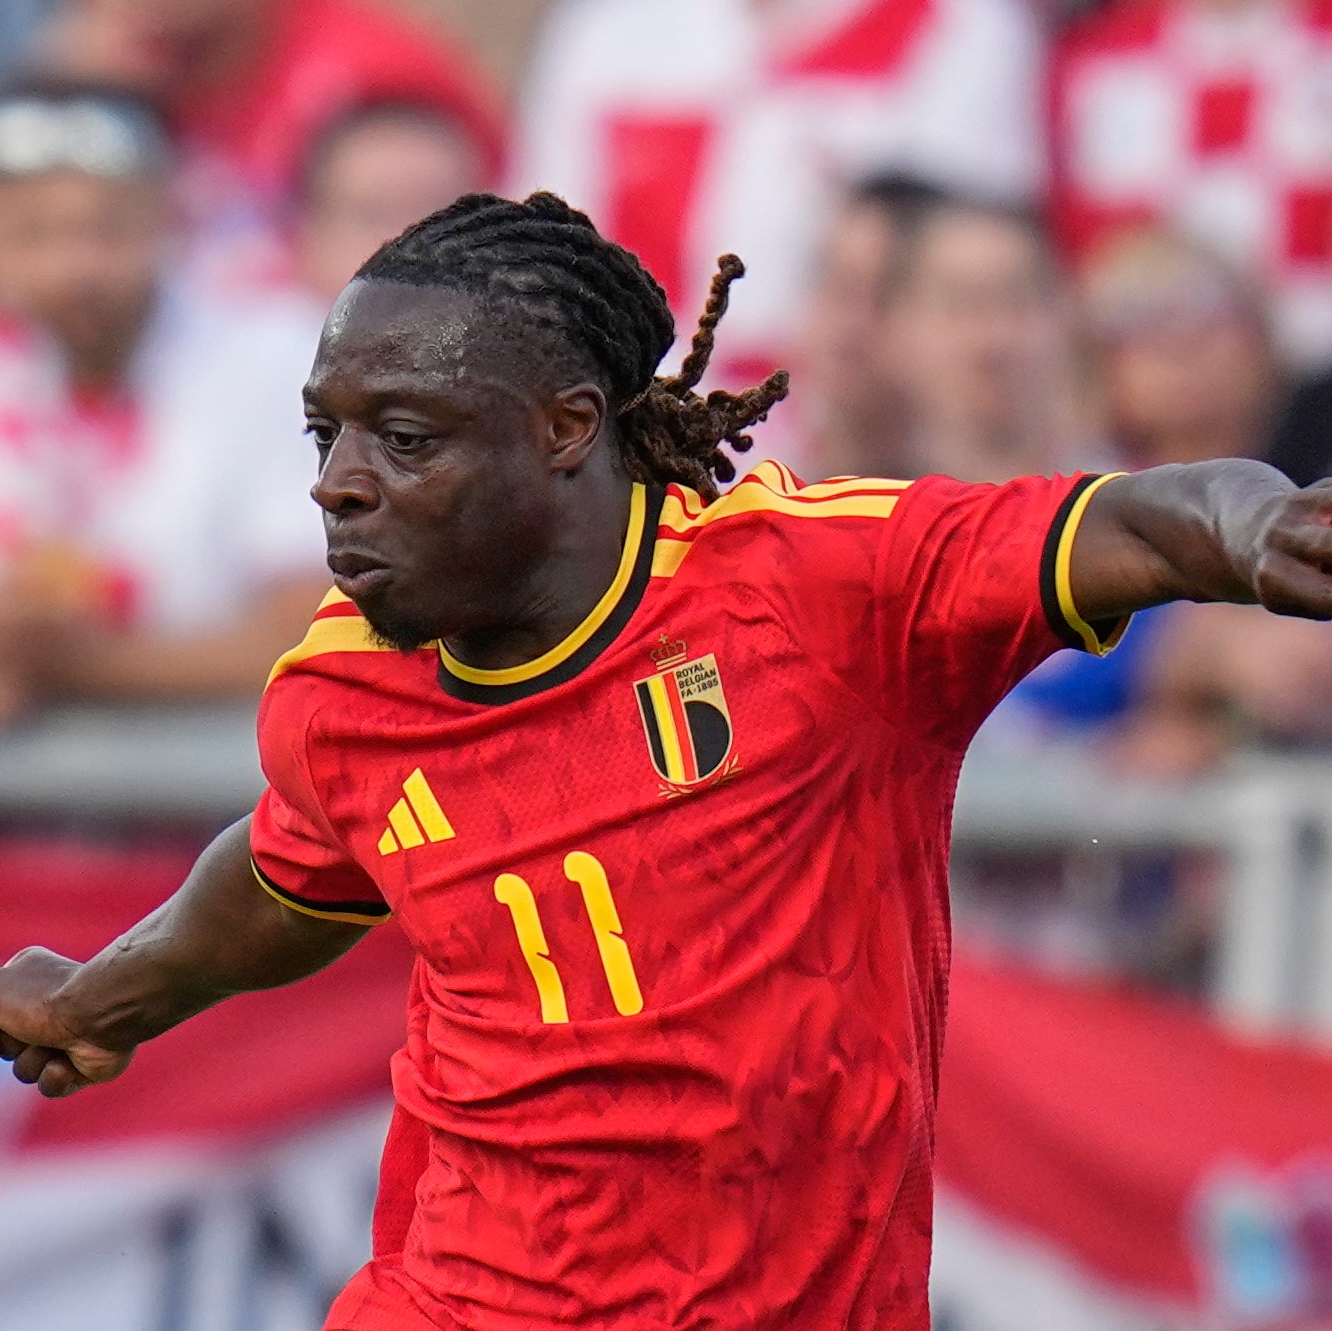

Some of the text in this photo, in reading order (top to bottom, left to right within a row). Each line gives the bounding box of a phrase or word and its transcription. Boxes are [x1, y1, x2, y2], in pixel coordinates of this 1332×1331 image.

[675, 663, 705, 679] ROYAL
[678, 668, 717, 689] BELGIAN
[494, 851, 644, 1024] 11
